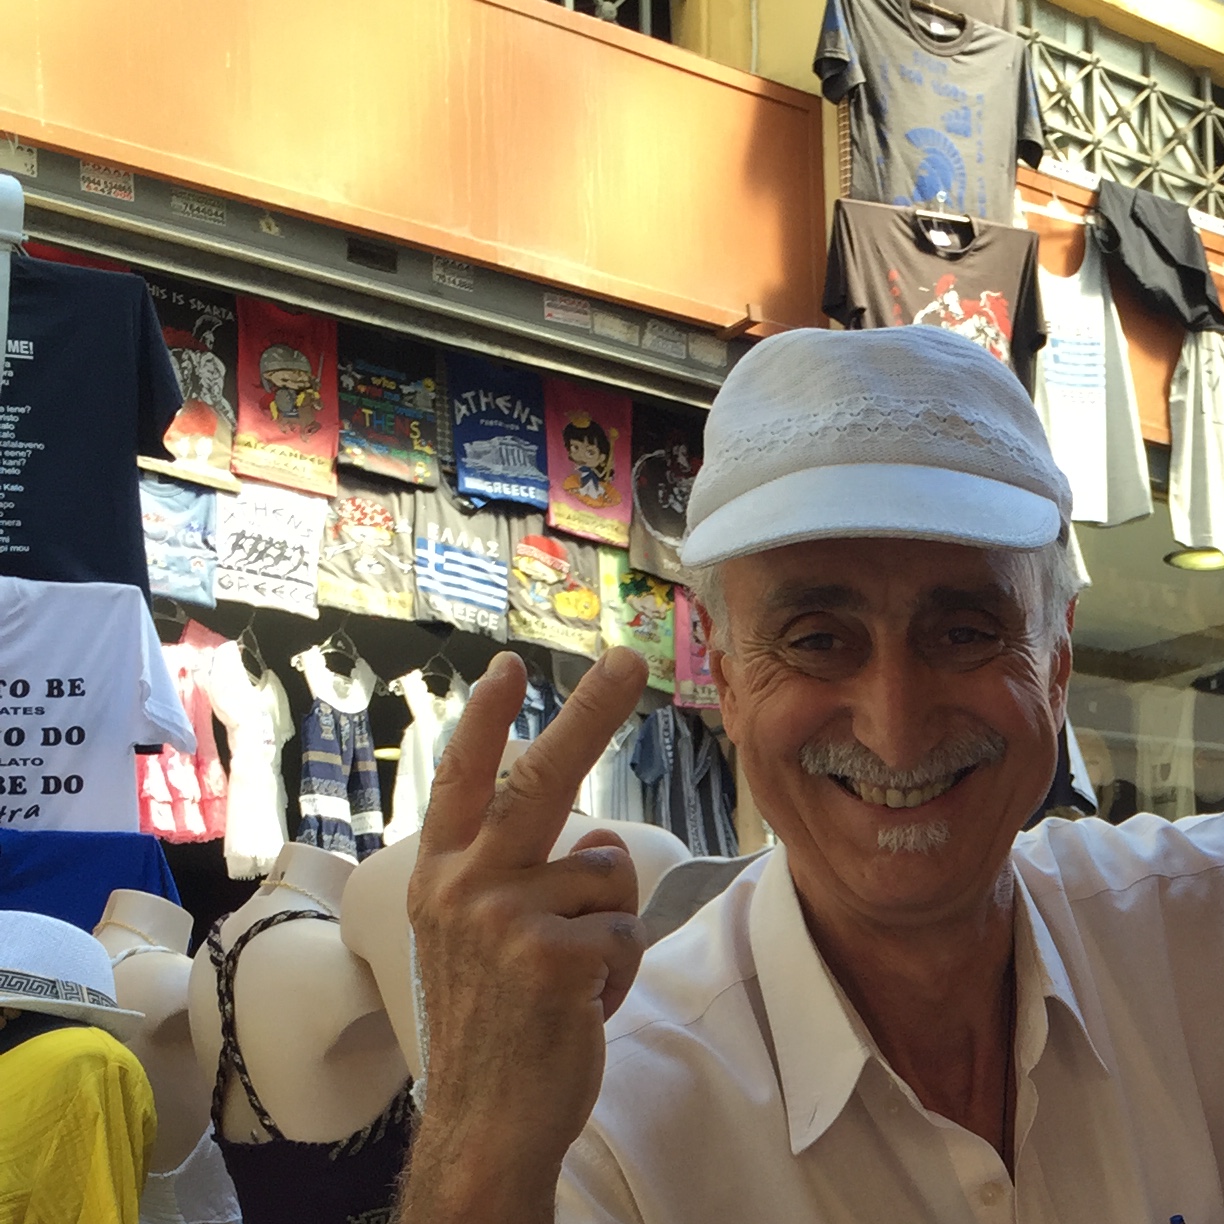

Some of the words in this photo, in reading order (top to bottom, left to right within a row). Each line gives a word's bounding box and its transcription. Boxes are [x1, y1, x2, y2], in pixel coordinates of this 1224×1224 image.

[147, 283, 167, 300] HIS
[172, 291, 185, 305] IS
[189, 298, 235, 322] SPARTA
[7, 339, 34, 354] ME!
[453, 389, 543, 432] ATHENS
[352, 407, 421, 439] ATHENS
[484, 482, 537, 499] GREECE
[45, 677, 86, 698] BE
[40, 725, 86, 746] DO
[40, 774, 84, 795] DO
